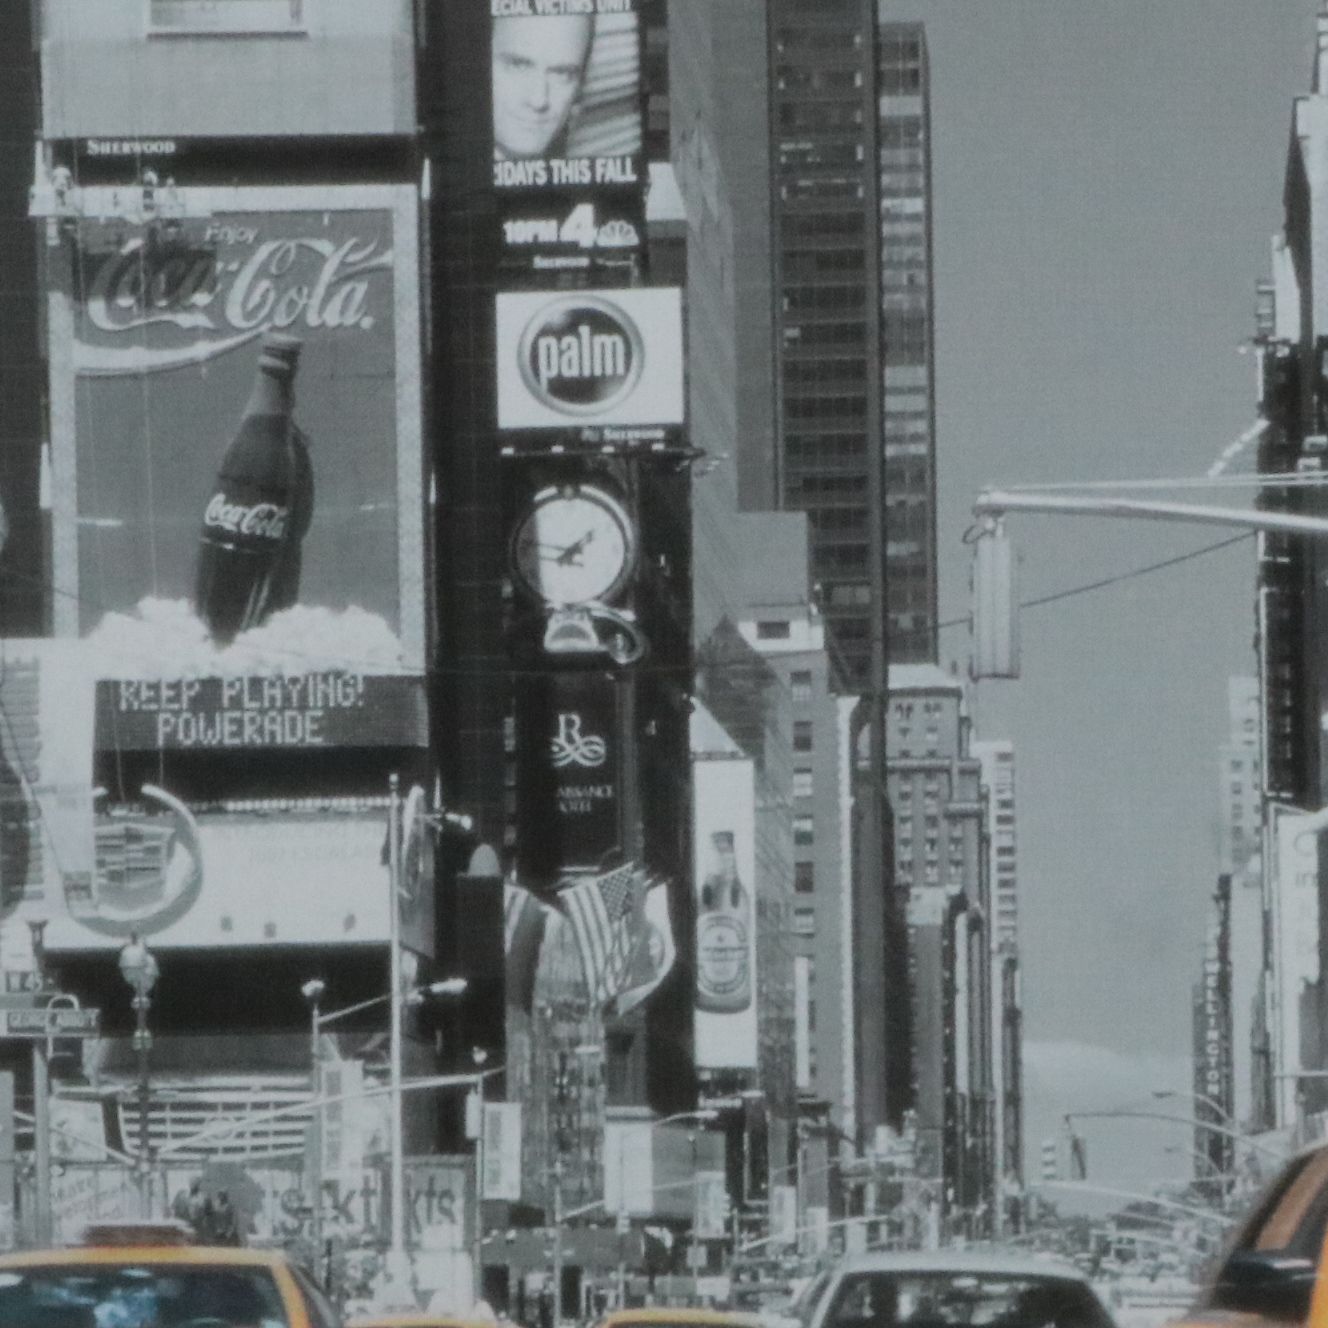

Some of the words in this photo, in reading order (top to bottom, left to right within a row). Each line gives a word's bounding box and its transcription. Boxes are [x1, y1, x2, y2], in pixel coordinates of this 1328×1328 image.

[86, 140, 176, 156] SHERWOOD
[550, 158, 592, 185] THIS
[595, 156, 638, 183] FALL
[559, 202, 598, 248] 4
[537, 325, 626, 395] palm
[222, 670, 365, 709] PLAYING!
[157, 709, 325, 748] POWERADE
